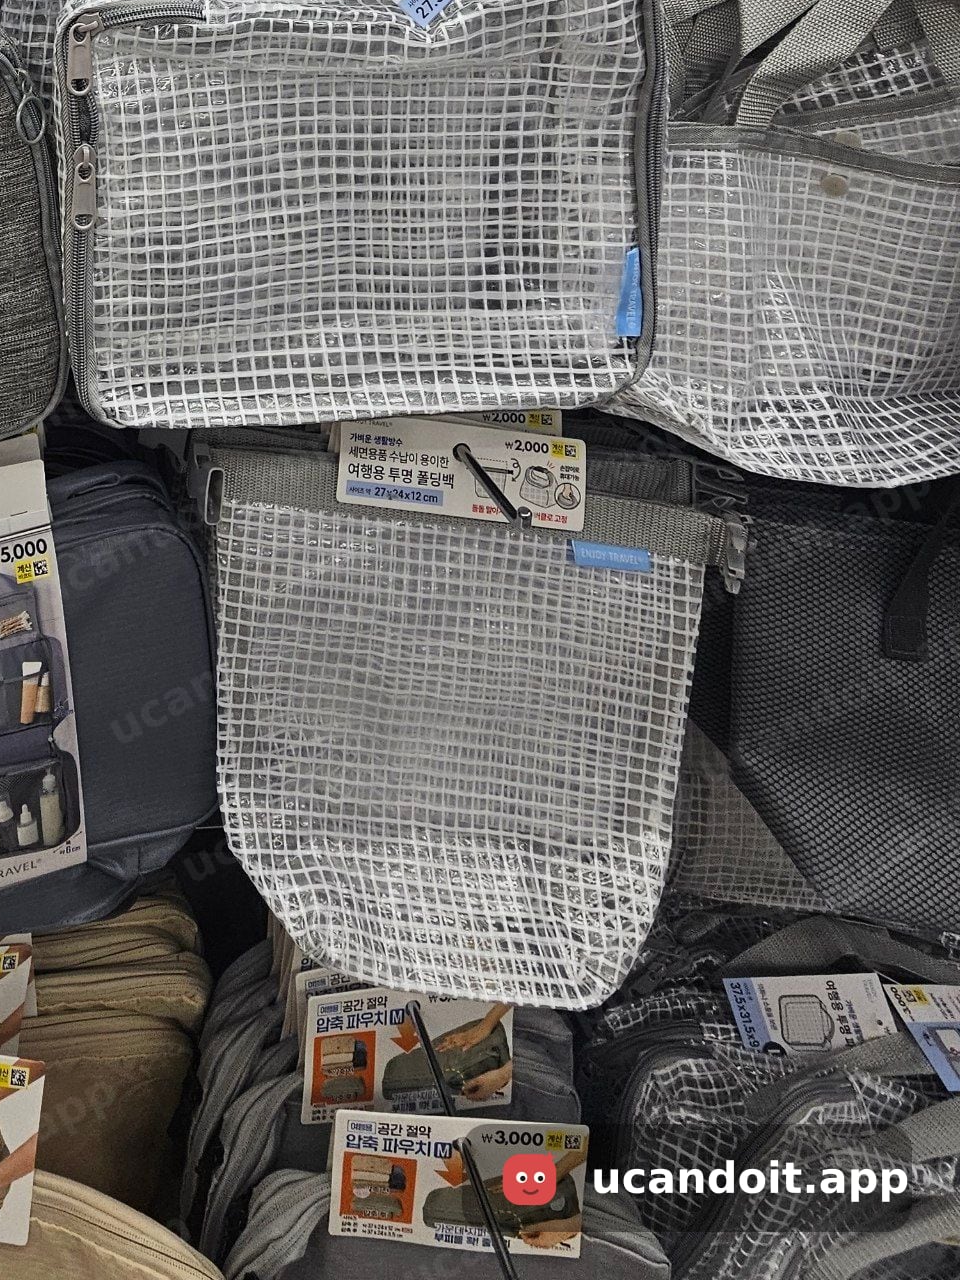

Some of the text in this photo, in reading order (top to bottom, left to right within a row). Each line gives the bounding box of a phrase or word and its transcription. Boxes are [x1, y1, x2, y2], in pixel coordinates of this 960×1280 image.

[349, 446, 449, 468] 세면용품 수납이 용이한
[348, 463, 454, 489] 여행용 투명 폴딩백
[424, 495, 438, 503] cm
[17, 563, 32, 573] 계산
[342, 999, 364, 1012] 공간
[367, 996, 388, 1009] 절약
[317, 1016, 343, 1033] 압축
[346, 1010, 388, 1029] 파우치
[378, 1123, 403, 1136] 공간
[407, 1125, 431, 1138] 절약
[346, 1134, 378, 1151] 압축
[382, 1138, 431, 1157] 파우치
